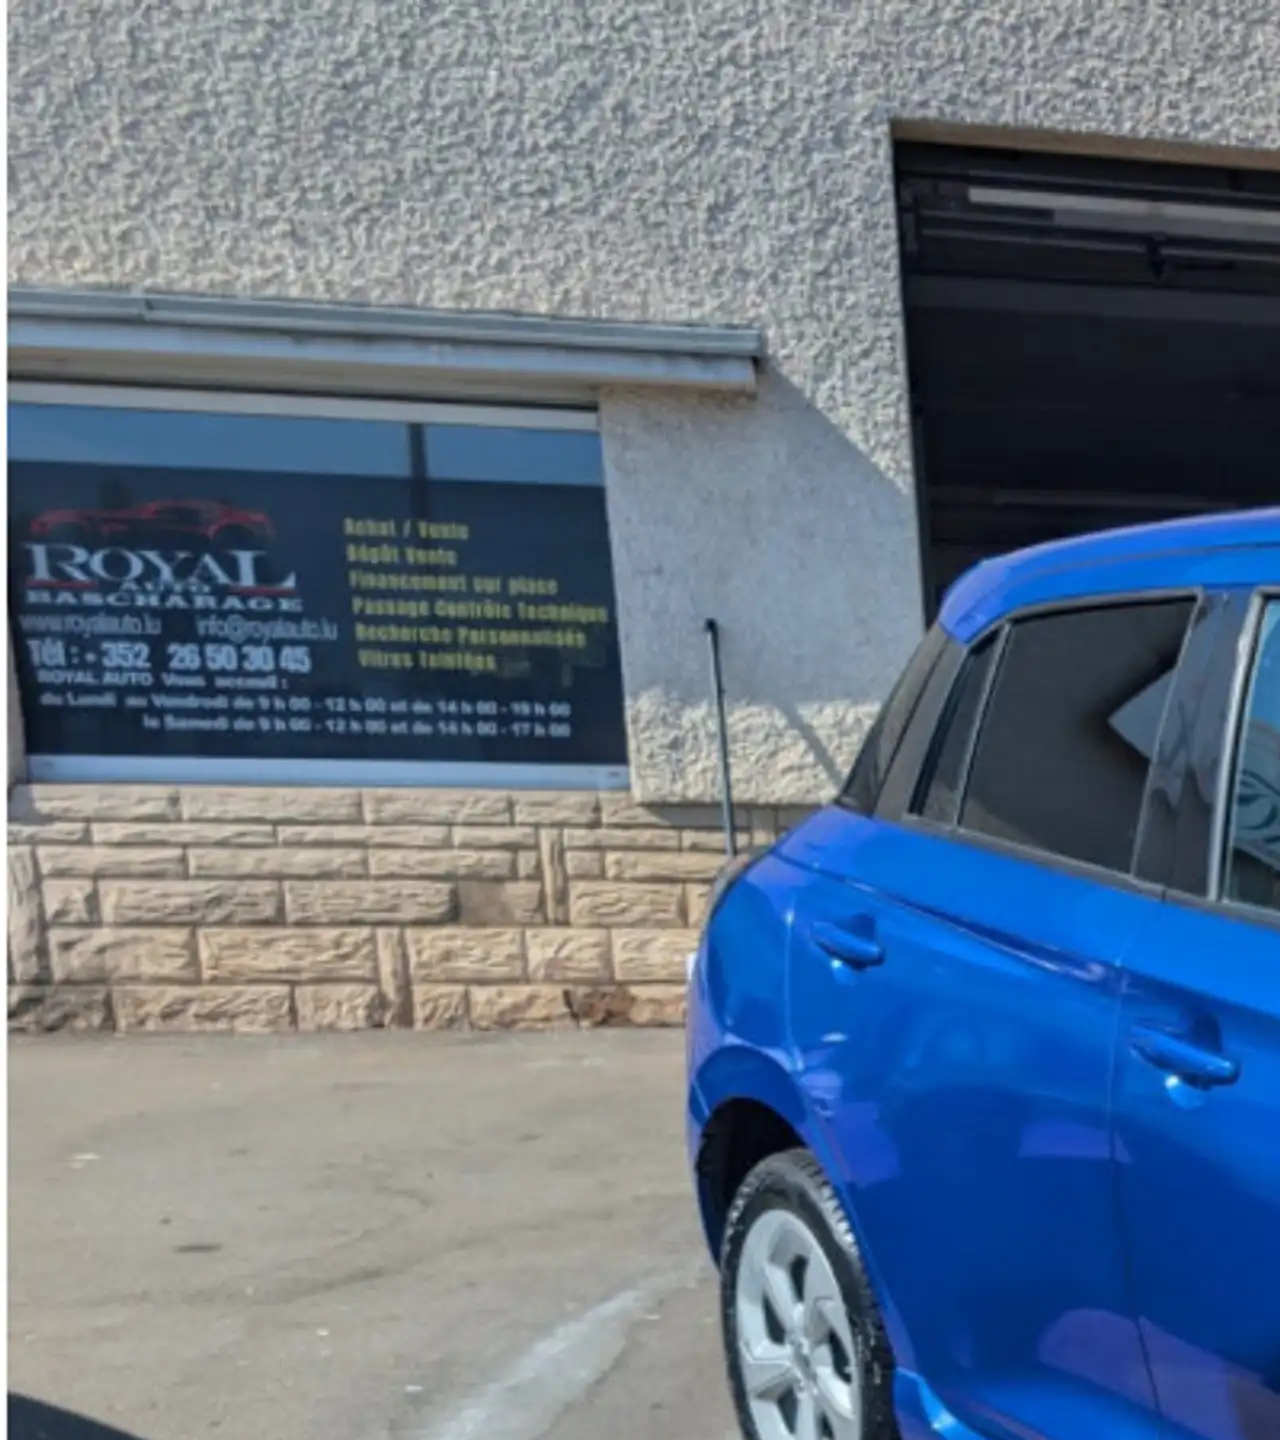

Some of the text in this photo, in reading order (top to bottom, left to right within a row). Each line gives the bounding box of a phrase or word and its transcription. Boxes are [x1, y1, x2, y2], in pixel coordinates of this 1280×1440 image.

[418, 521, 469, 540] Vente
[23, 543, 296, 588] ROYAL
[406, 547, 457, 566] Vente
[349, 570, 558, 596] Financement sur place
[25, 590, 304, 611] BASCHARAGE
[352, 596, 429, 618] Passage
[518, 602, 608, 624] Technique
[18, 613, 161, 638] www.royalauto.lu
[196, 614, 338, 642] info@royalauto.lu
[355, 622, 452, 642] Recherche
[101, 640, 152, 670] 352
[166, 642, 201, 671] 26
[205, 644, 237, 671] 50
[241, 645, 275, 672] 30
[279, 645, 312, 674] 45
[358, 649, 413, 668] Vitres
[37, 669, 98, 685] ROYAL
[102, 671, 153, 687] AUTO
